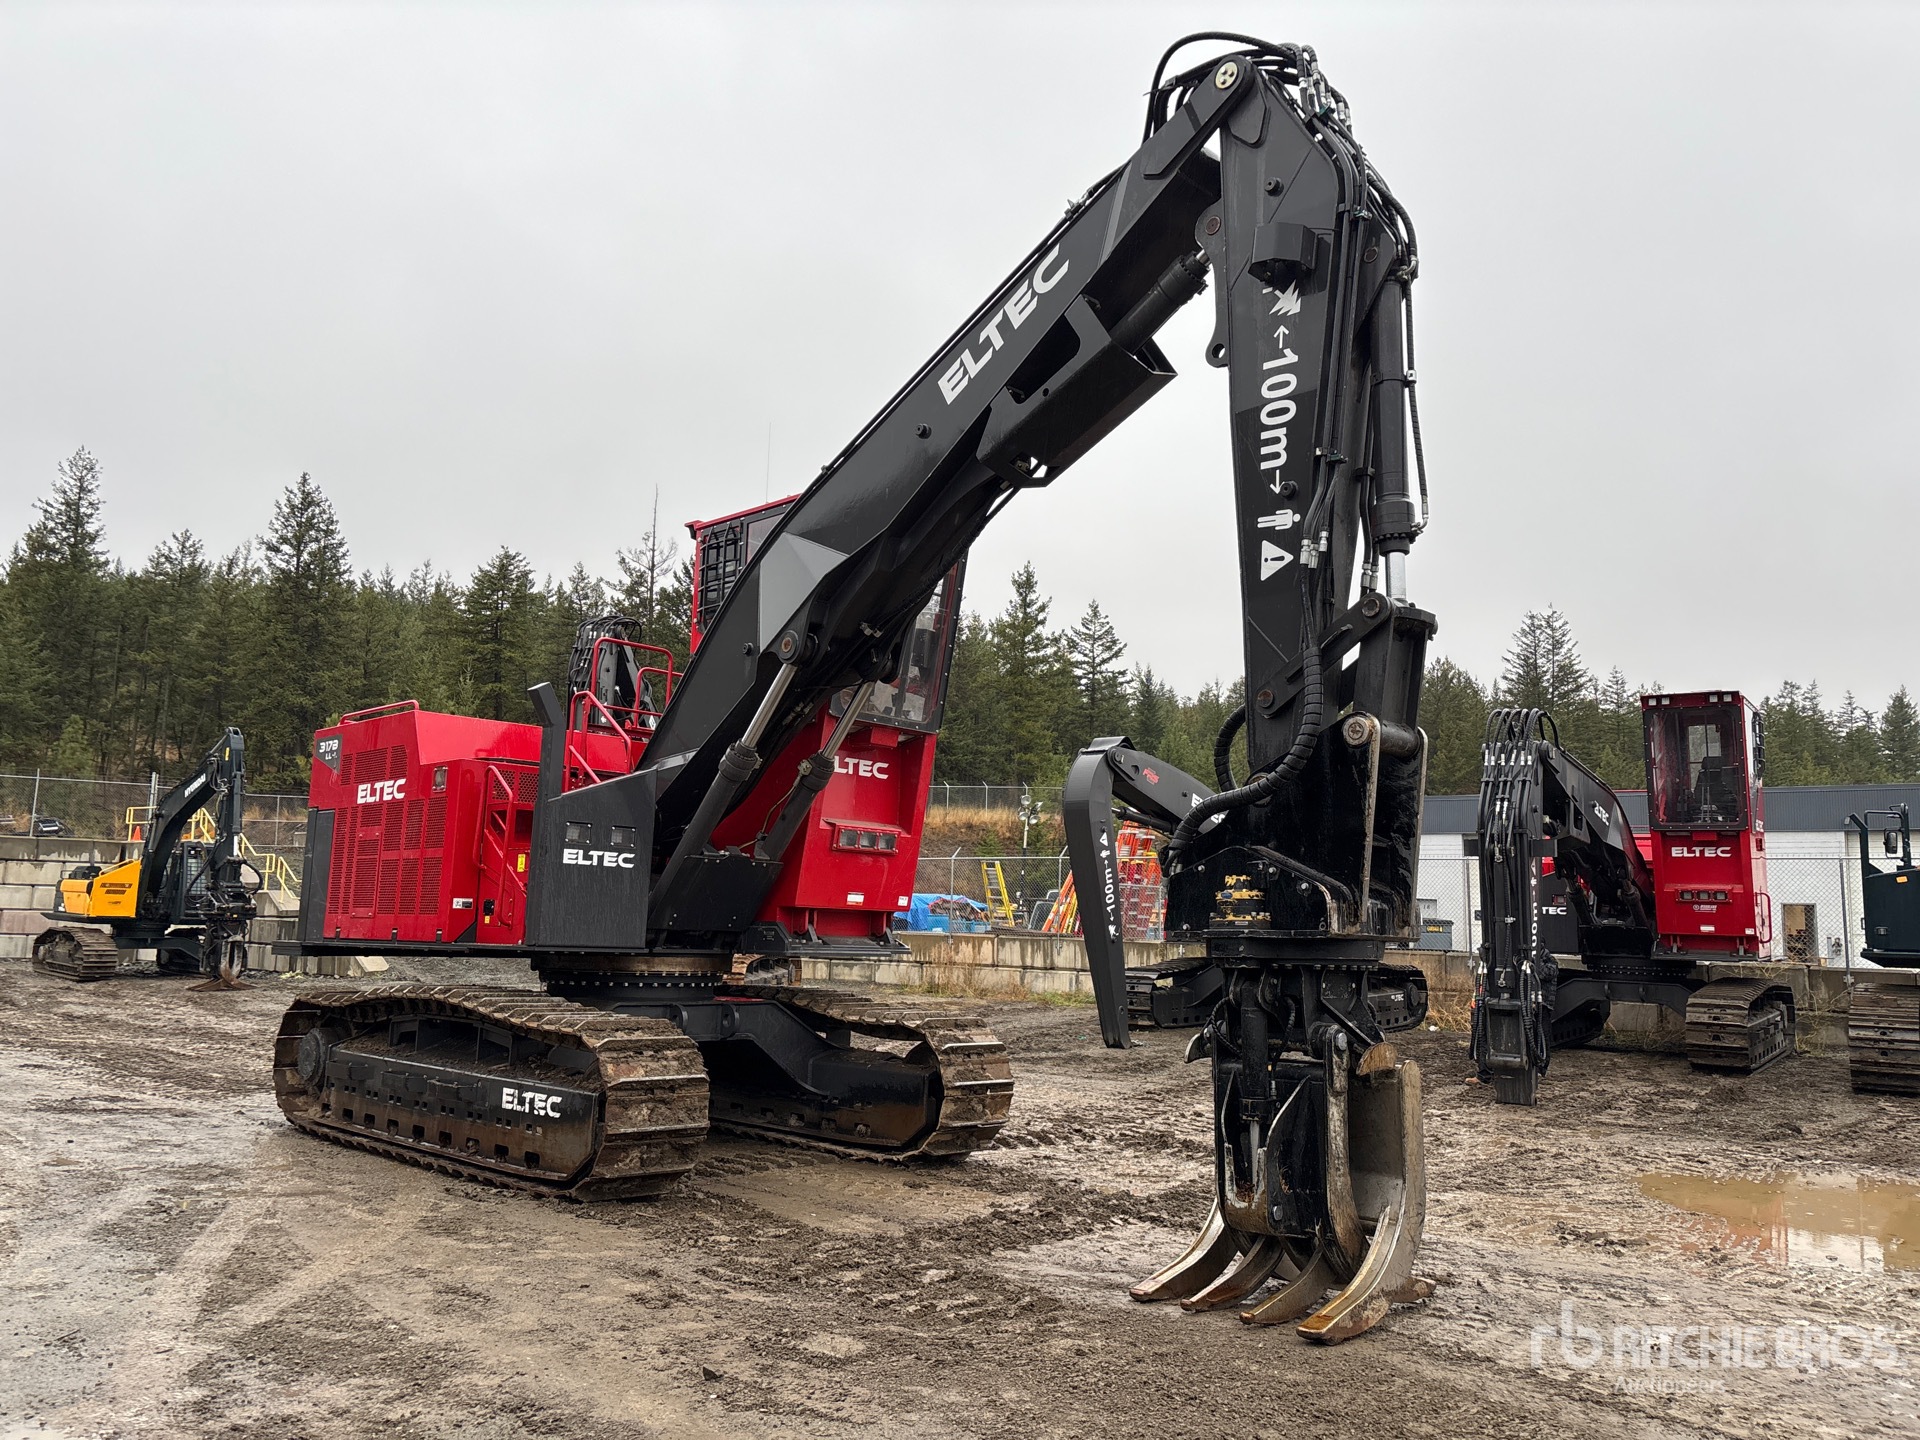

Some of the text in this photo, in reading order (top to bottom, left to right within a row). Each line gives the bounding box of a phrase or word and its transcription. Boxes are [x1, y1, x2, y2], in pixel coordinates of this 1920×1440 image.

[938, 243, 1069, 405] ELTEC
[1260, 348, 1298, 470] 100m
[834, 756, 889, 779] LTEC
[357, 779, 406, 804] ELTEC
[563, 849, 635, 868] ELTEC
[1671, 846, 1731, 858] ELTEC
[1541, 906, 1567, 915] TEC
[502, 1087, 562, 1118] ELTEC
